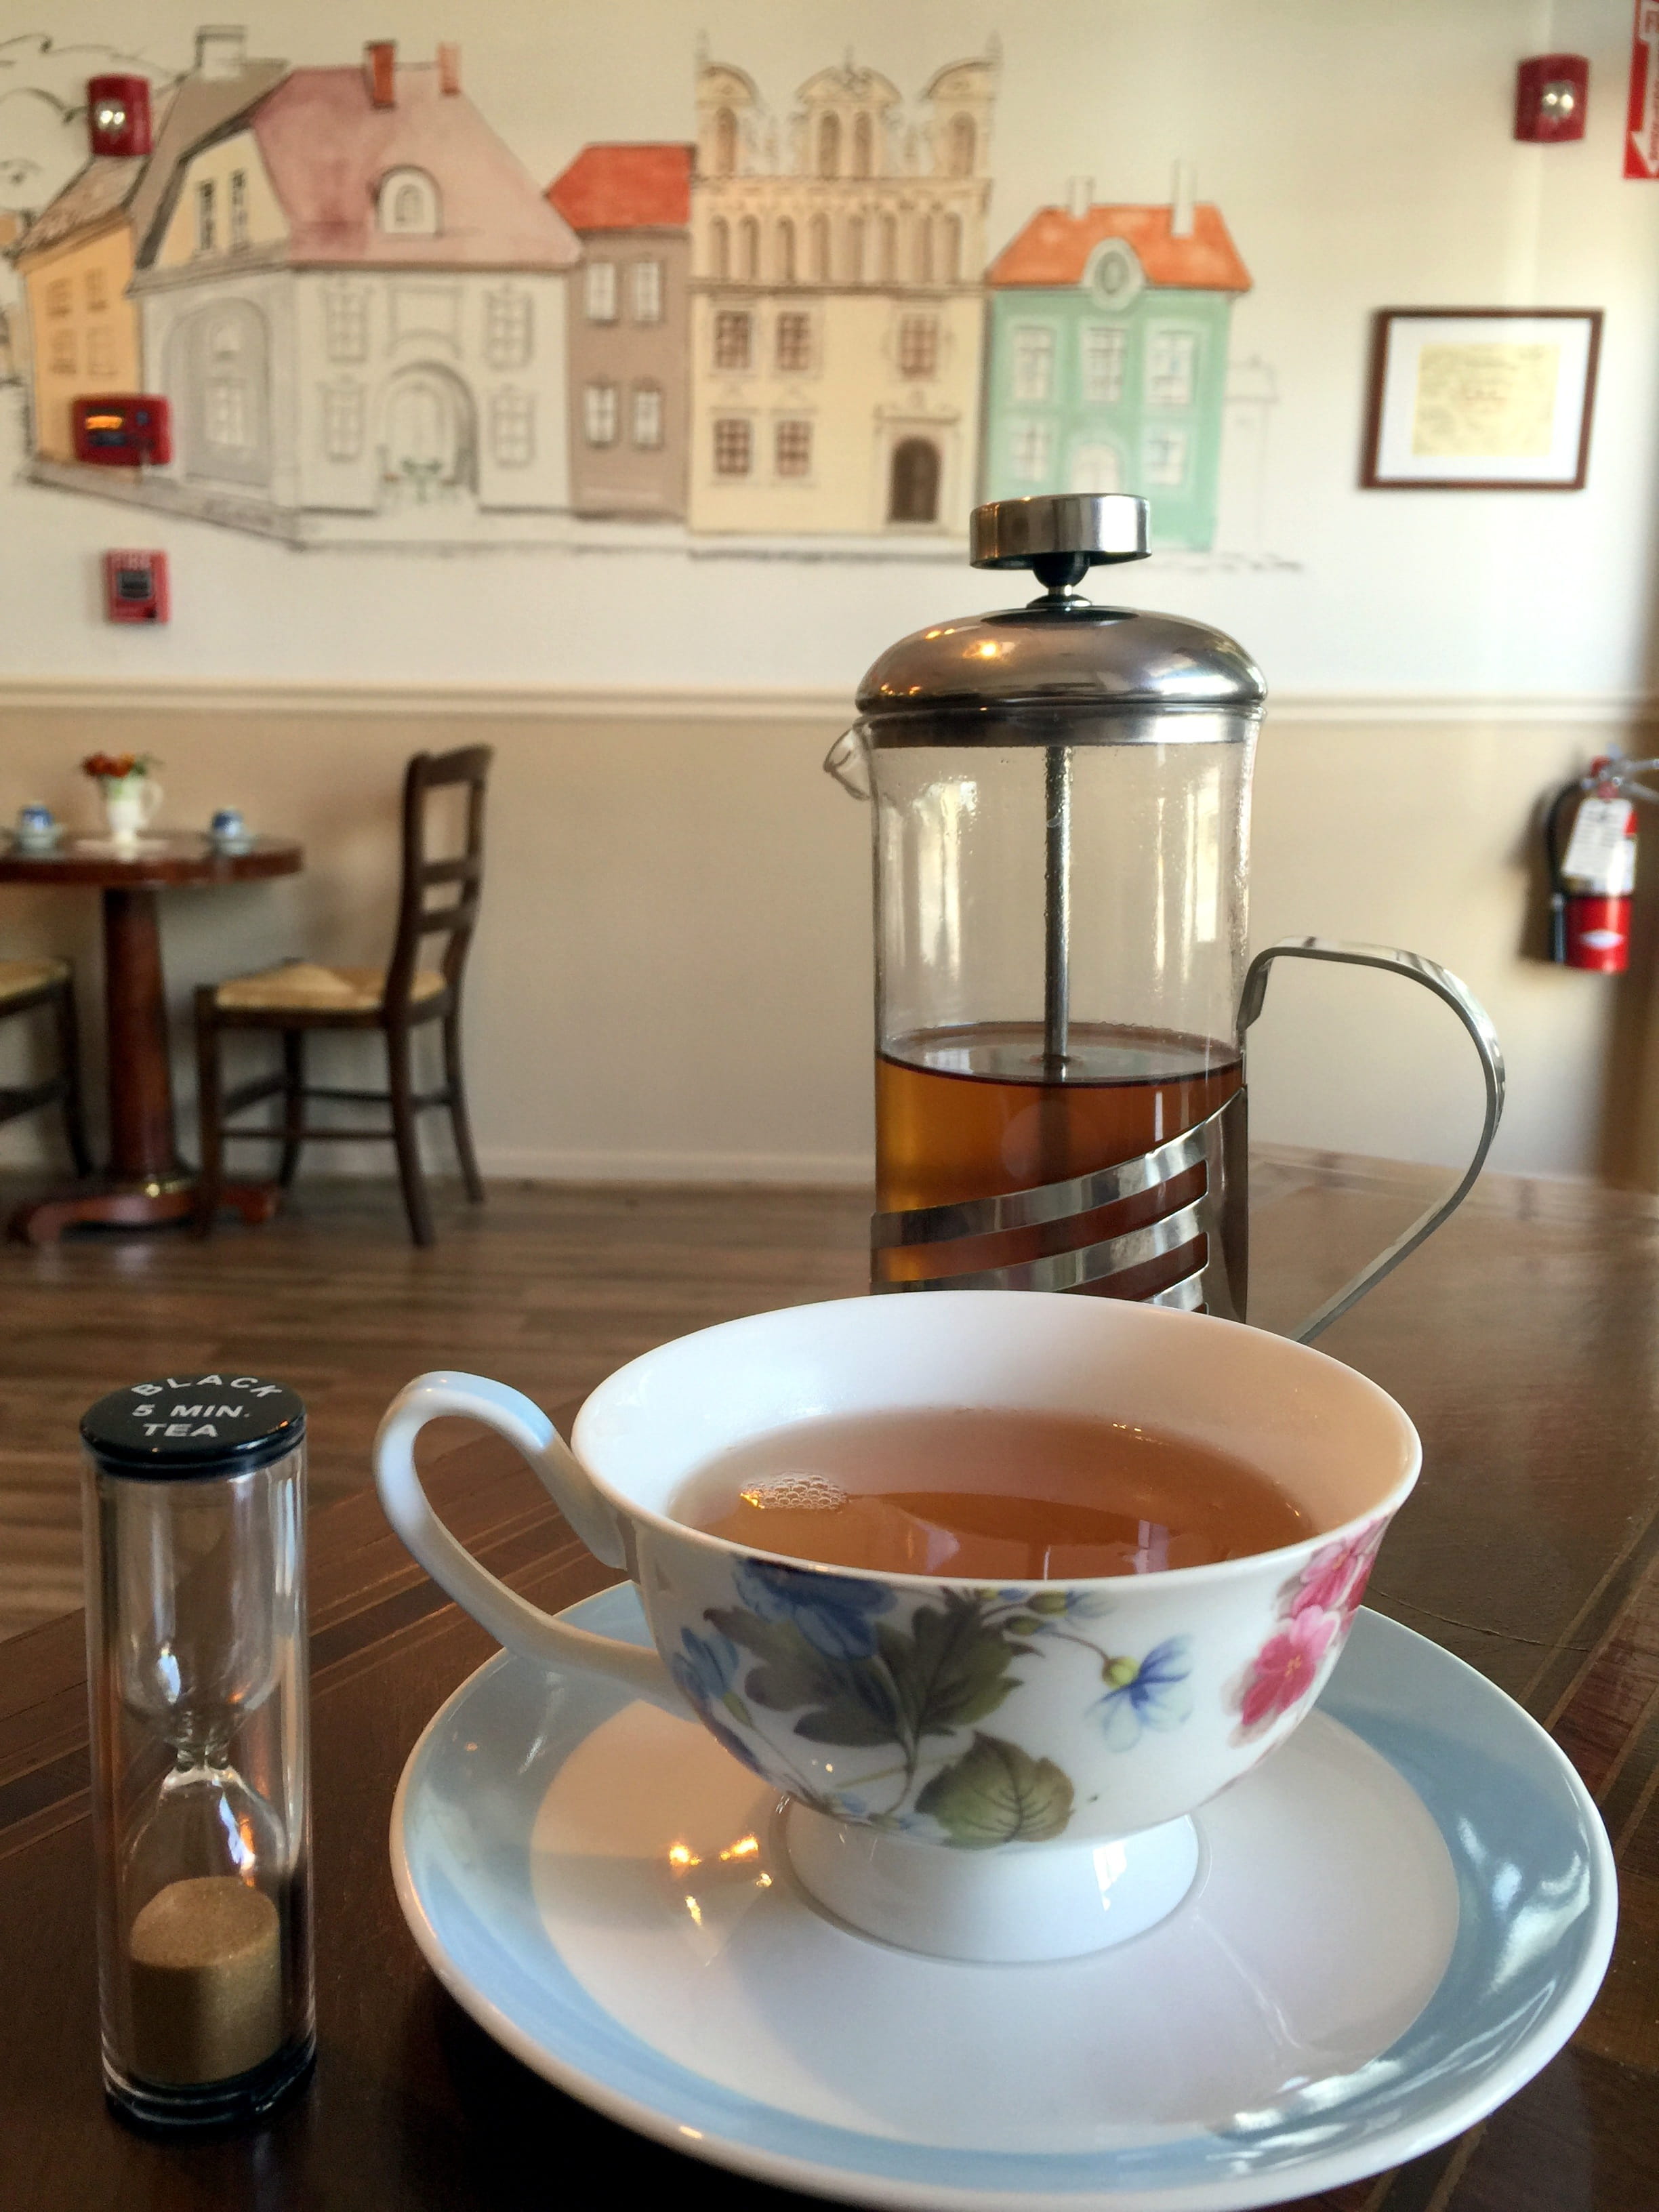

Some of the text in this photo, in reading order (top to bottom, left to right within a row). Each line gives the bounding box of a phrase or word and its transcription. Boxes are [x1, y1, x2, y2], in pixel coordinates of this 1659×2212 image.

[131, 1375, 282, 1397] BLACK
[132, 1404, 250, 1418] 5 MIN.
[142, 1423, 218, 1437] TEA
